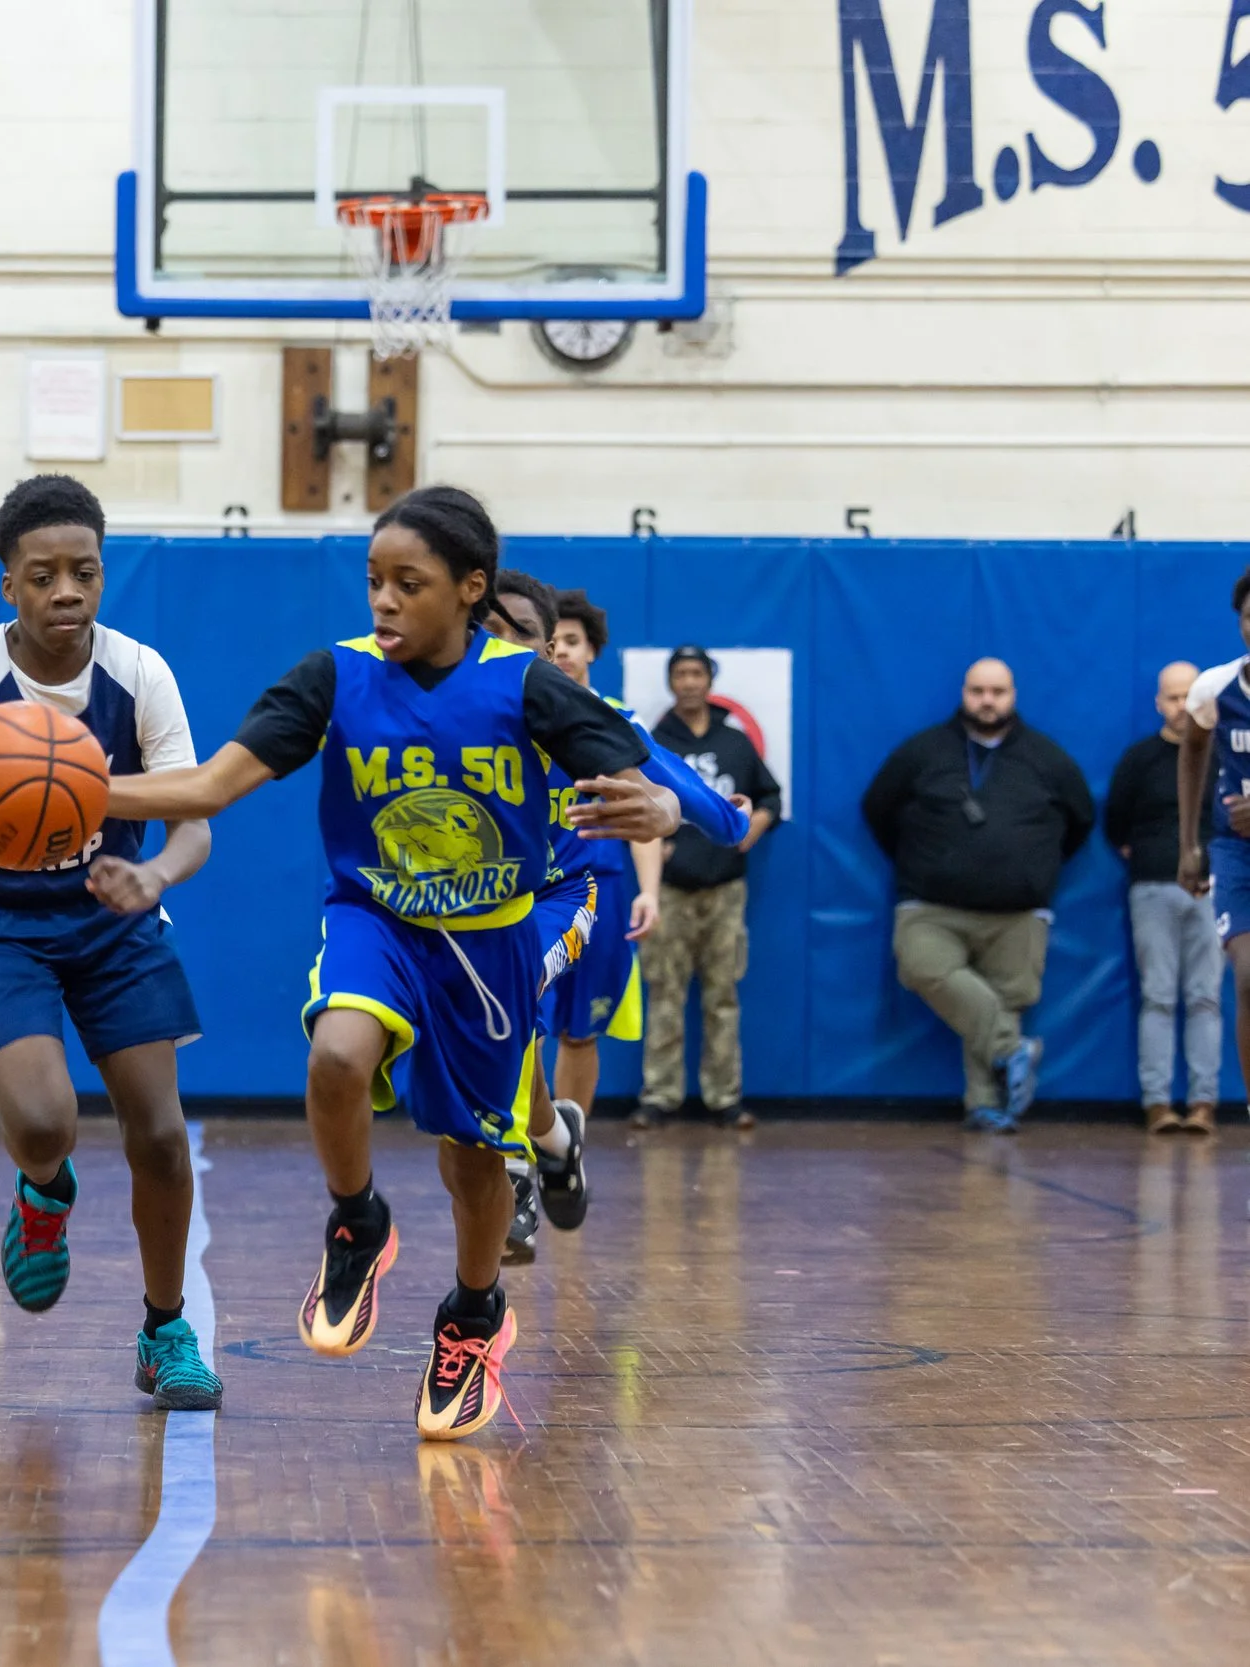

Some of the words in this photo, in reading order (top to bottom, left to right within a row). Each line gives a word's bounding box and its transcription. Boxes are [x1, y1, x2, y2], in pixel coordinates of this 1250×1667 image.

[834, 0, 1161, 276] M.S.
[345, 746, 448, 803] M.S.
[461, 745, 525, 806] 50
[372, 866, 516, 918] WARRIORS
